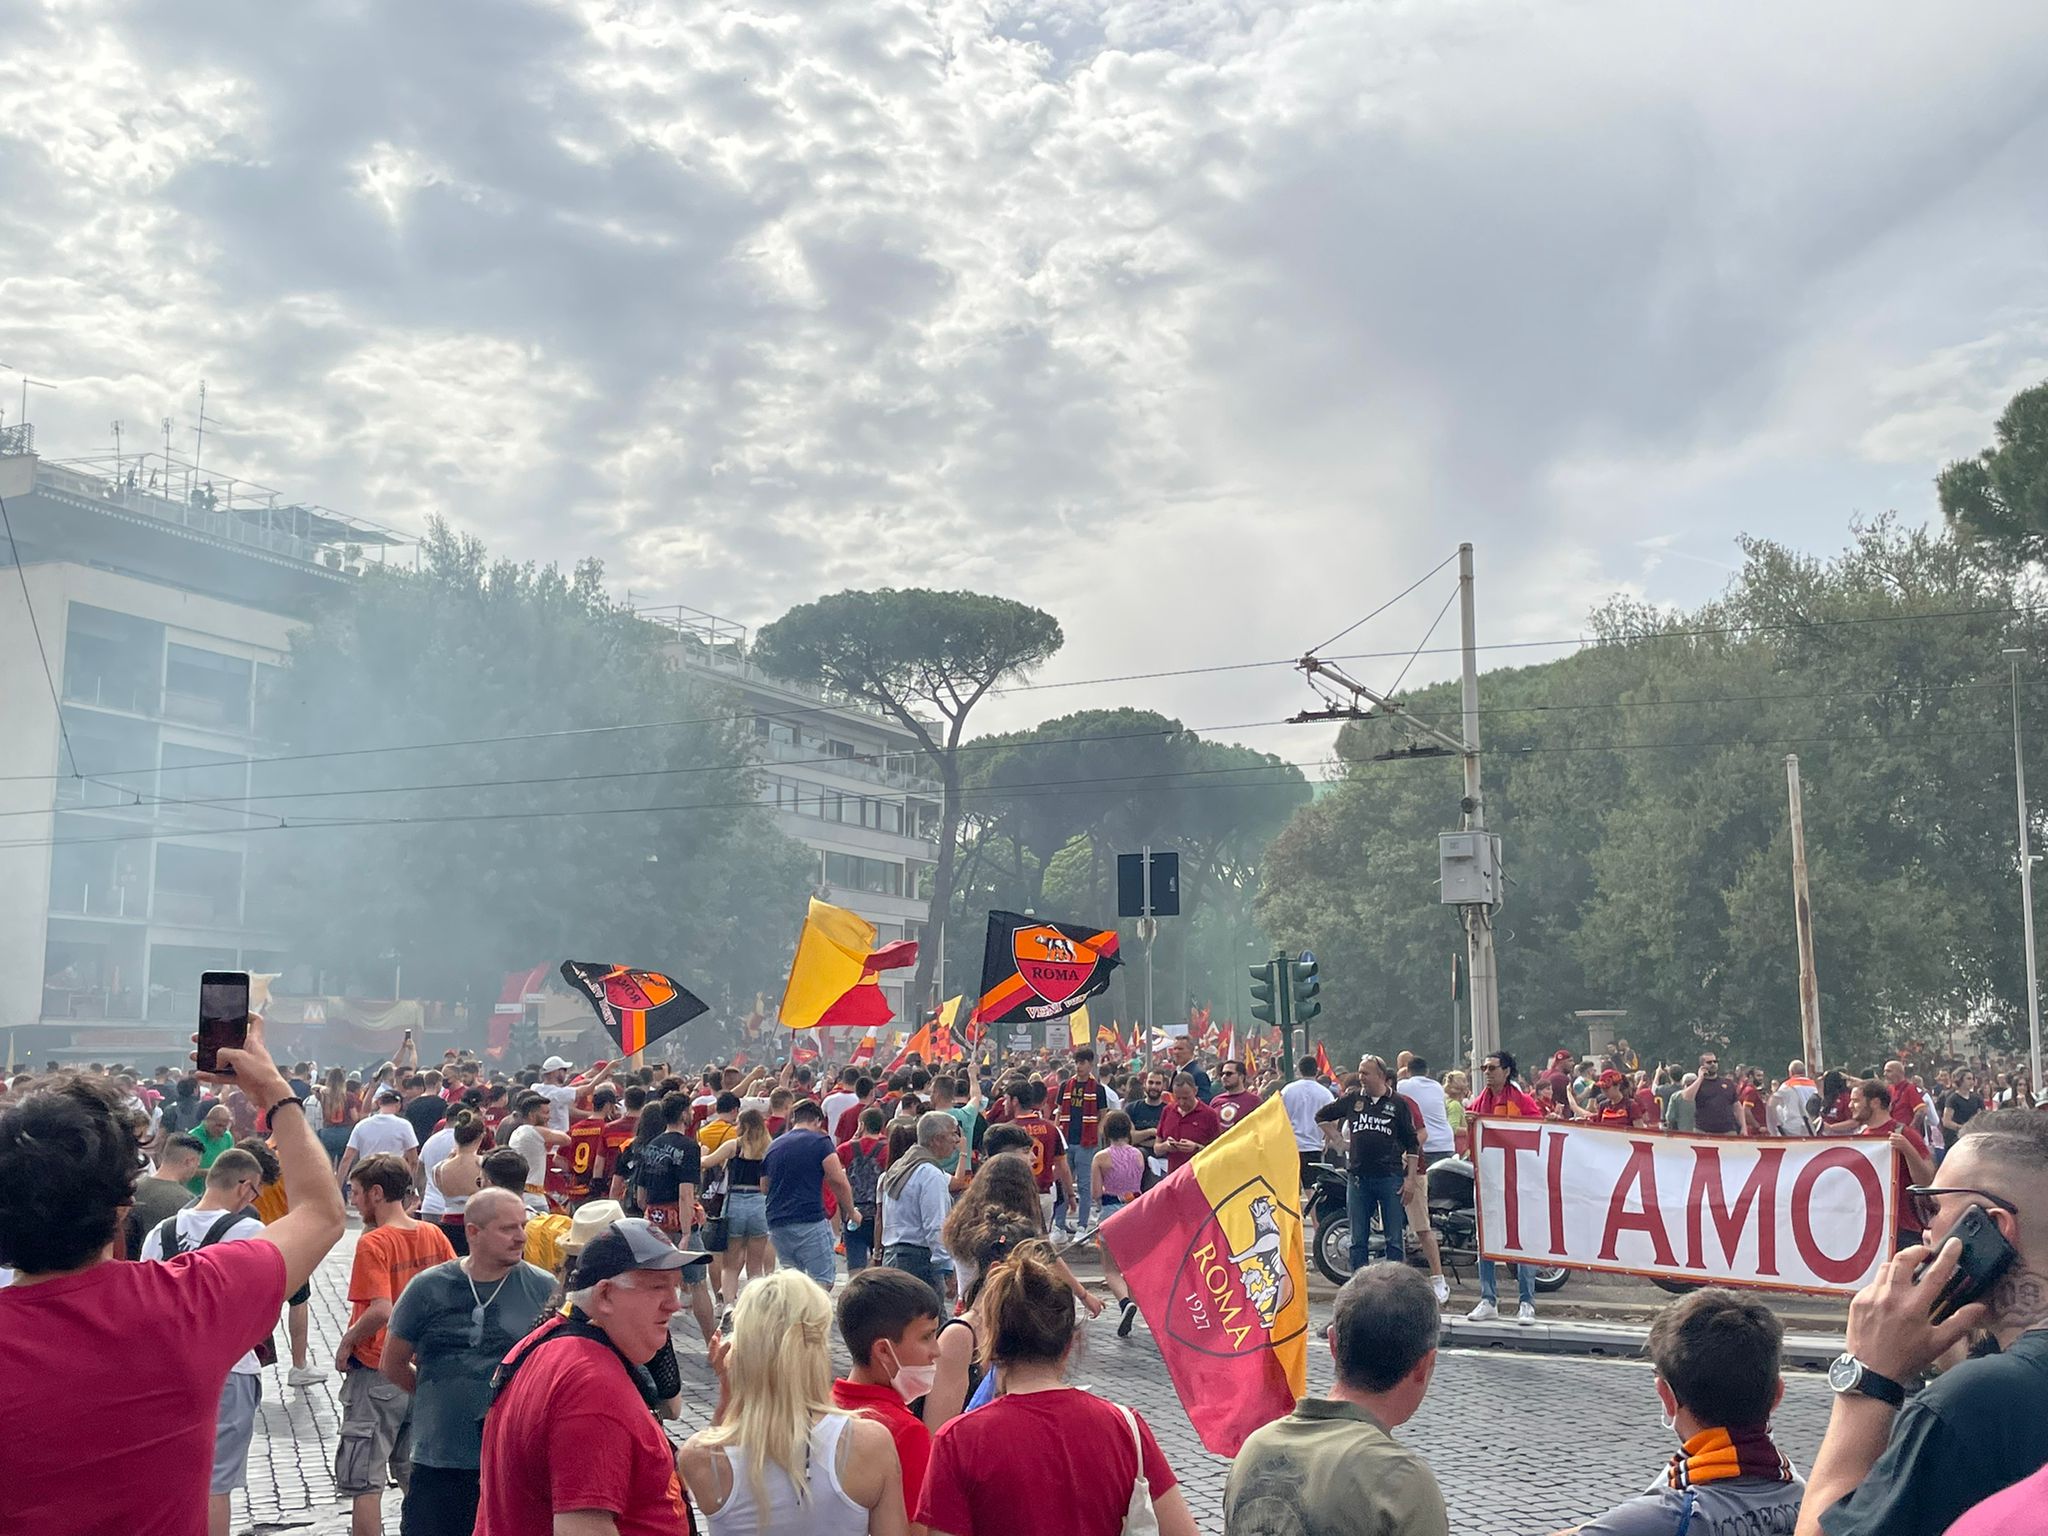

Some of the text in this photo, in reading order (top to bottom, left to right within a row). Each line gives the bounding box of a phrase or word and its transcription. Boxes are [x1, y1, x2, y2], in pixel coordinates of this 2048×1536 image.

[1032, 967, 1080, 981] ROMA
[573, 1142, 590, 1174] 9
[1481, 1126, 1884, 1284] TI AMO
[1185, 1292, 1211, 1331] 1927
[1193, 1241, 1253, 1351] ROMA
